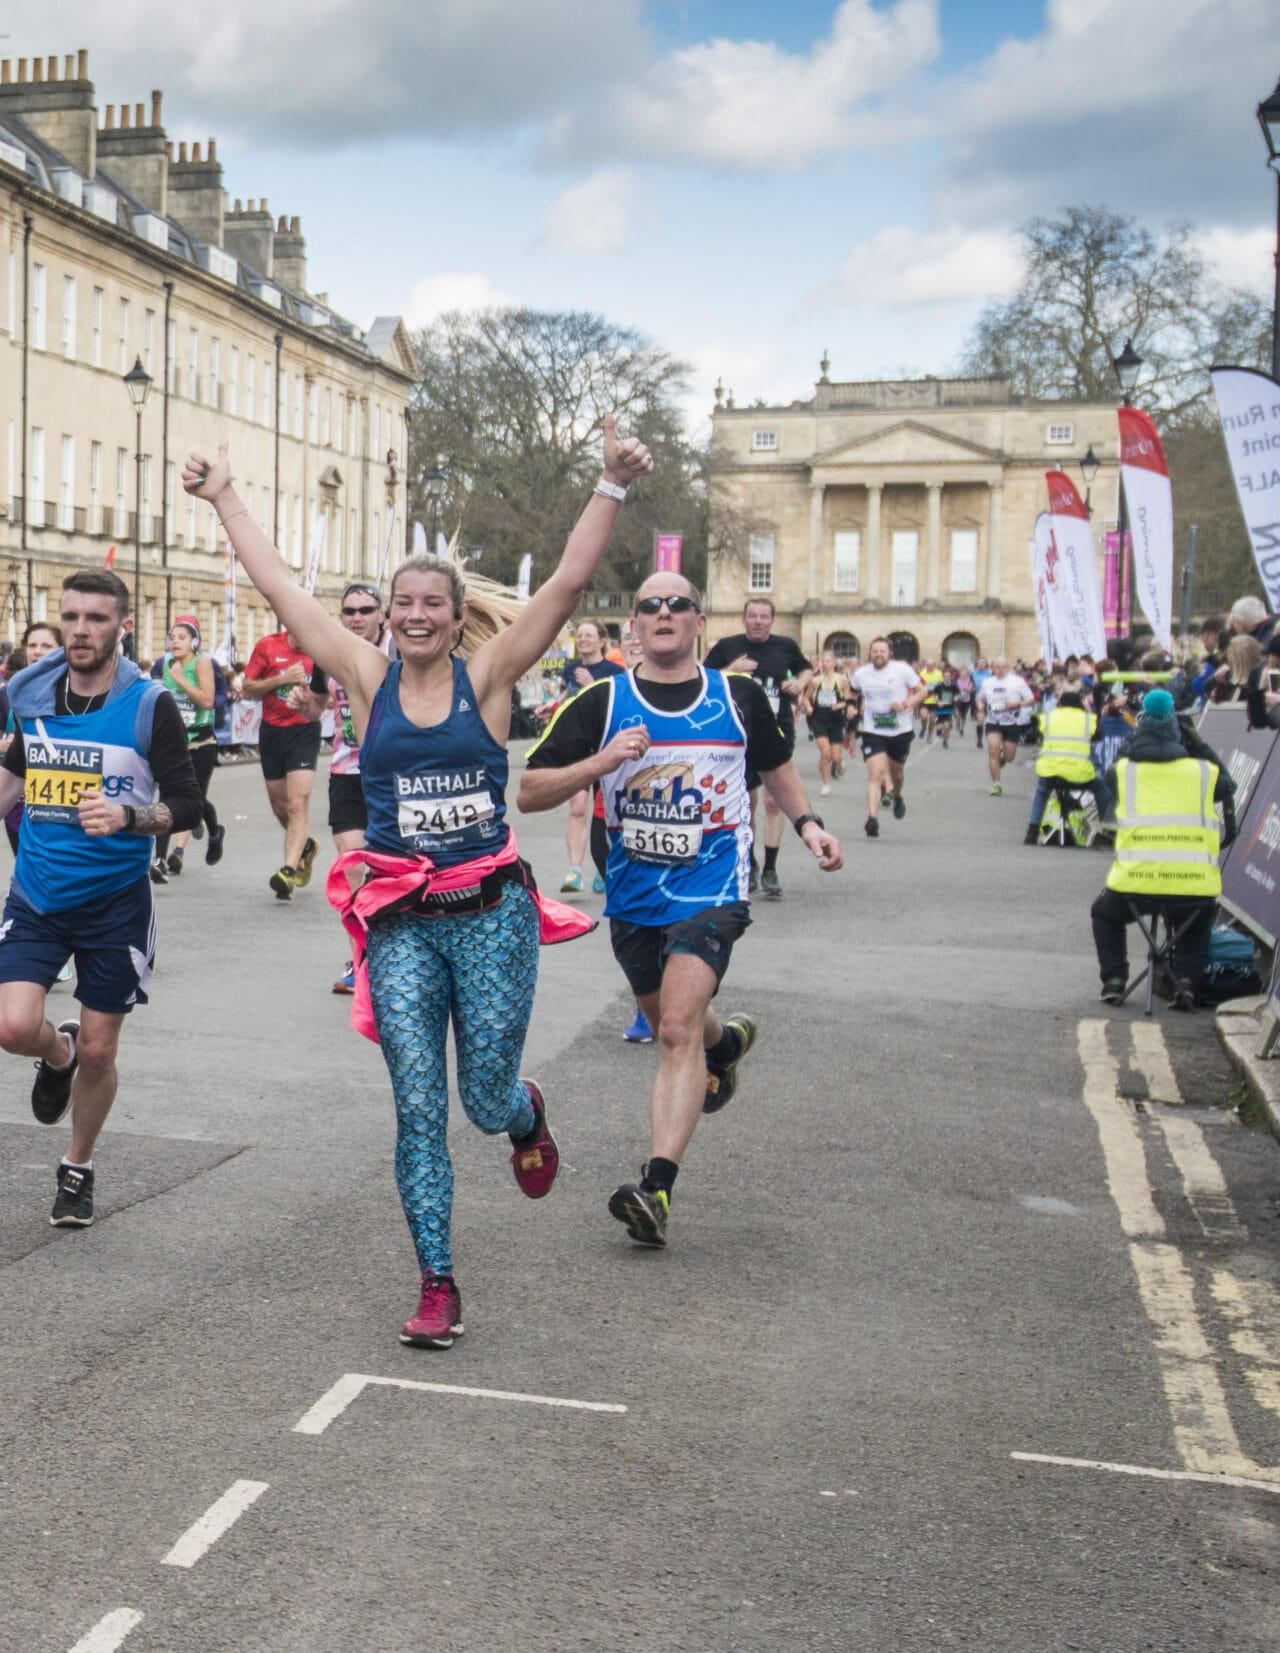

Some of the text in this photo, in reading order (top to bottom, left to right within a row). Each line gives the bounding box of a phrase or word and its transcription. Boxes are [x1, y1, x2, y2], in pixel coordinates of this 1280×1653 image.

[103, 775, 134, 797] gs
[397, 769, 486, 796] BATHALF
[413, 804, 479, 833] 2412
[625, 803, 700, 820] BATHALF
[635, 828, 690, 856] 5163
